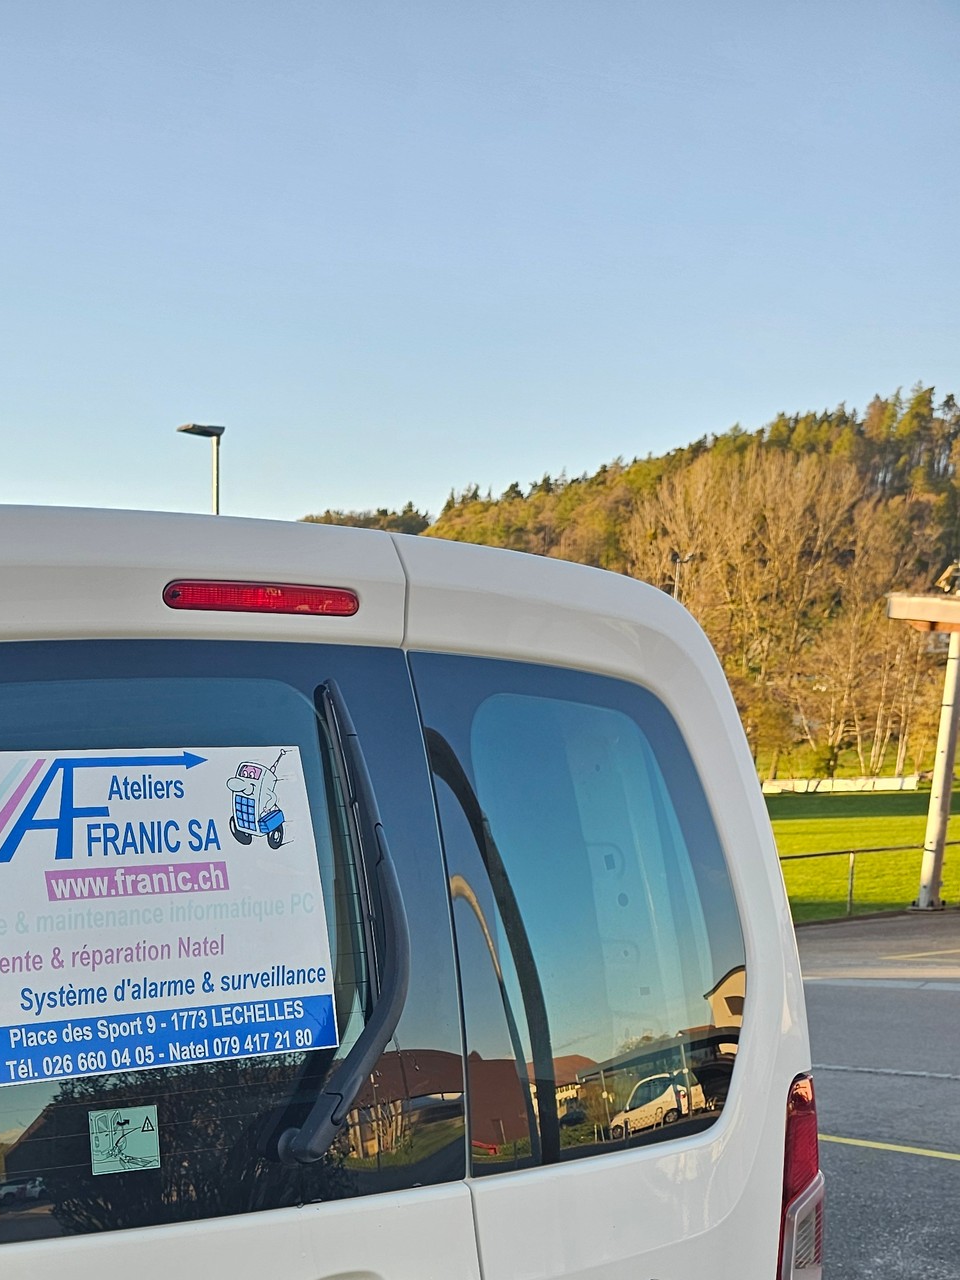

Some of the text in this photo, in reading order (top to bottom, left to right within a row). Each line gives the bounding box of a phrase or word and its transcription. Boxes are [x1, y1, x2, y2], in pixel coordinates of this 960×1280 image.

[108, 775, 185, 801] Ateliers
[87, 818, 221, 857] FRANIC SA
[51, 864, 225, 899] www.franic.ch
[15, 912, 30, 933] &
[36, 904, 164, 932] maintenance
[169, 897, 285, 922] informatique
[291, 892, 315, 914] PC
[51, 947, 65, 969] &
[71, 939, 171, 972] réparation
[178, 934, 225, 960] Natel
[20, 965, 326, 1016] Système d'alarme & surveillance
[10, 1025, 57, 1049] Place
[62, 1020, 93, 1043] des
[97, 1017, 142, 1043] Sport
[146, 1015, 156, 1032] 9
[170, 1010, 208, 1032] 1773
[212, 1000, 304, 1027] LECHELLES
[6, 1059, 38, 1080] Tél.
[43, 1054, 74, 1075] 026
[78, 1052, 107, 1071] 660
[111, 1049, 131, 1068] 04
[135, 1046, 155, 1065] 05
[169, 1040, 209, 1063] Natel
[213, 1035, 240, 1056] 079
[244, 1033, 270, 1052] 417
[274, 1030, 292, 1049] 21
[295, 1028, 312, 1046] 80
